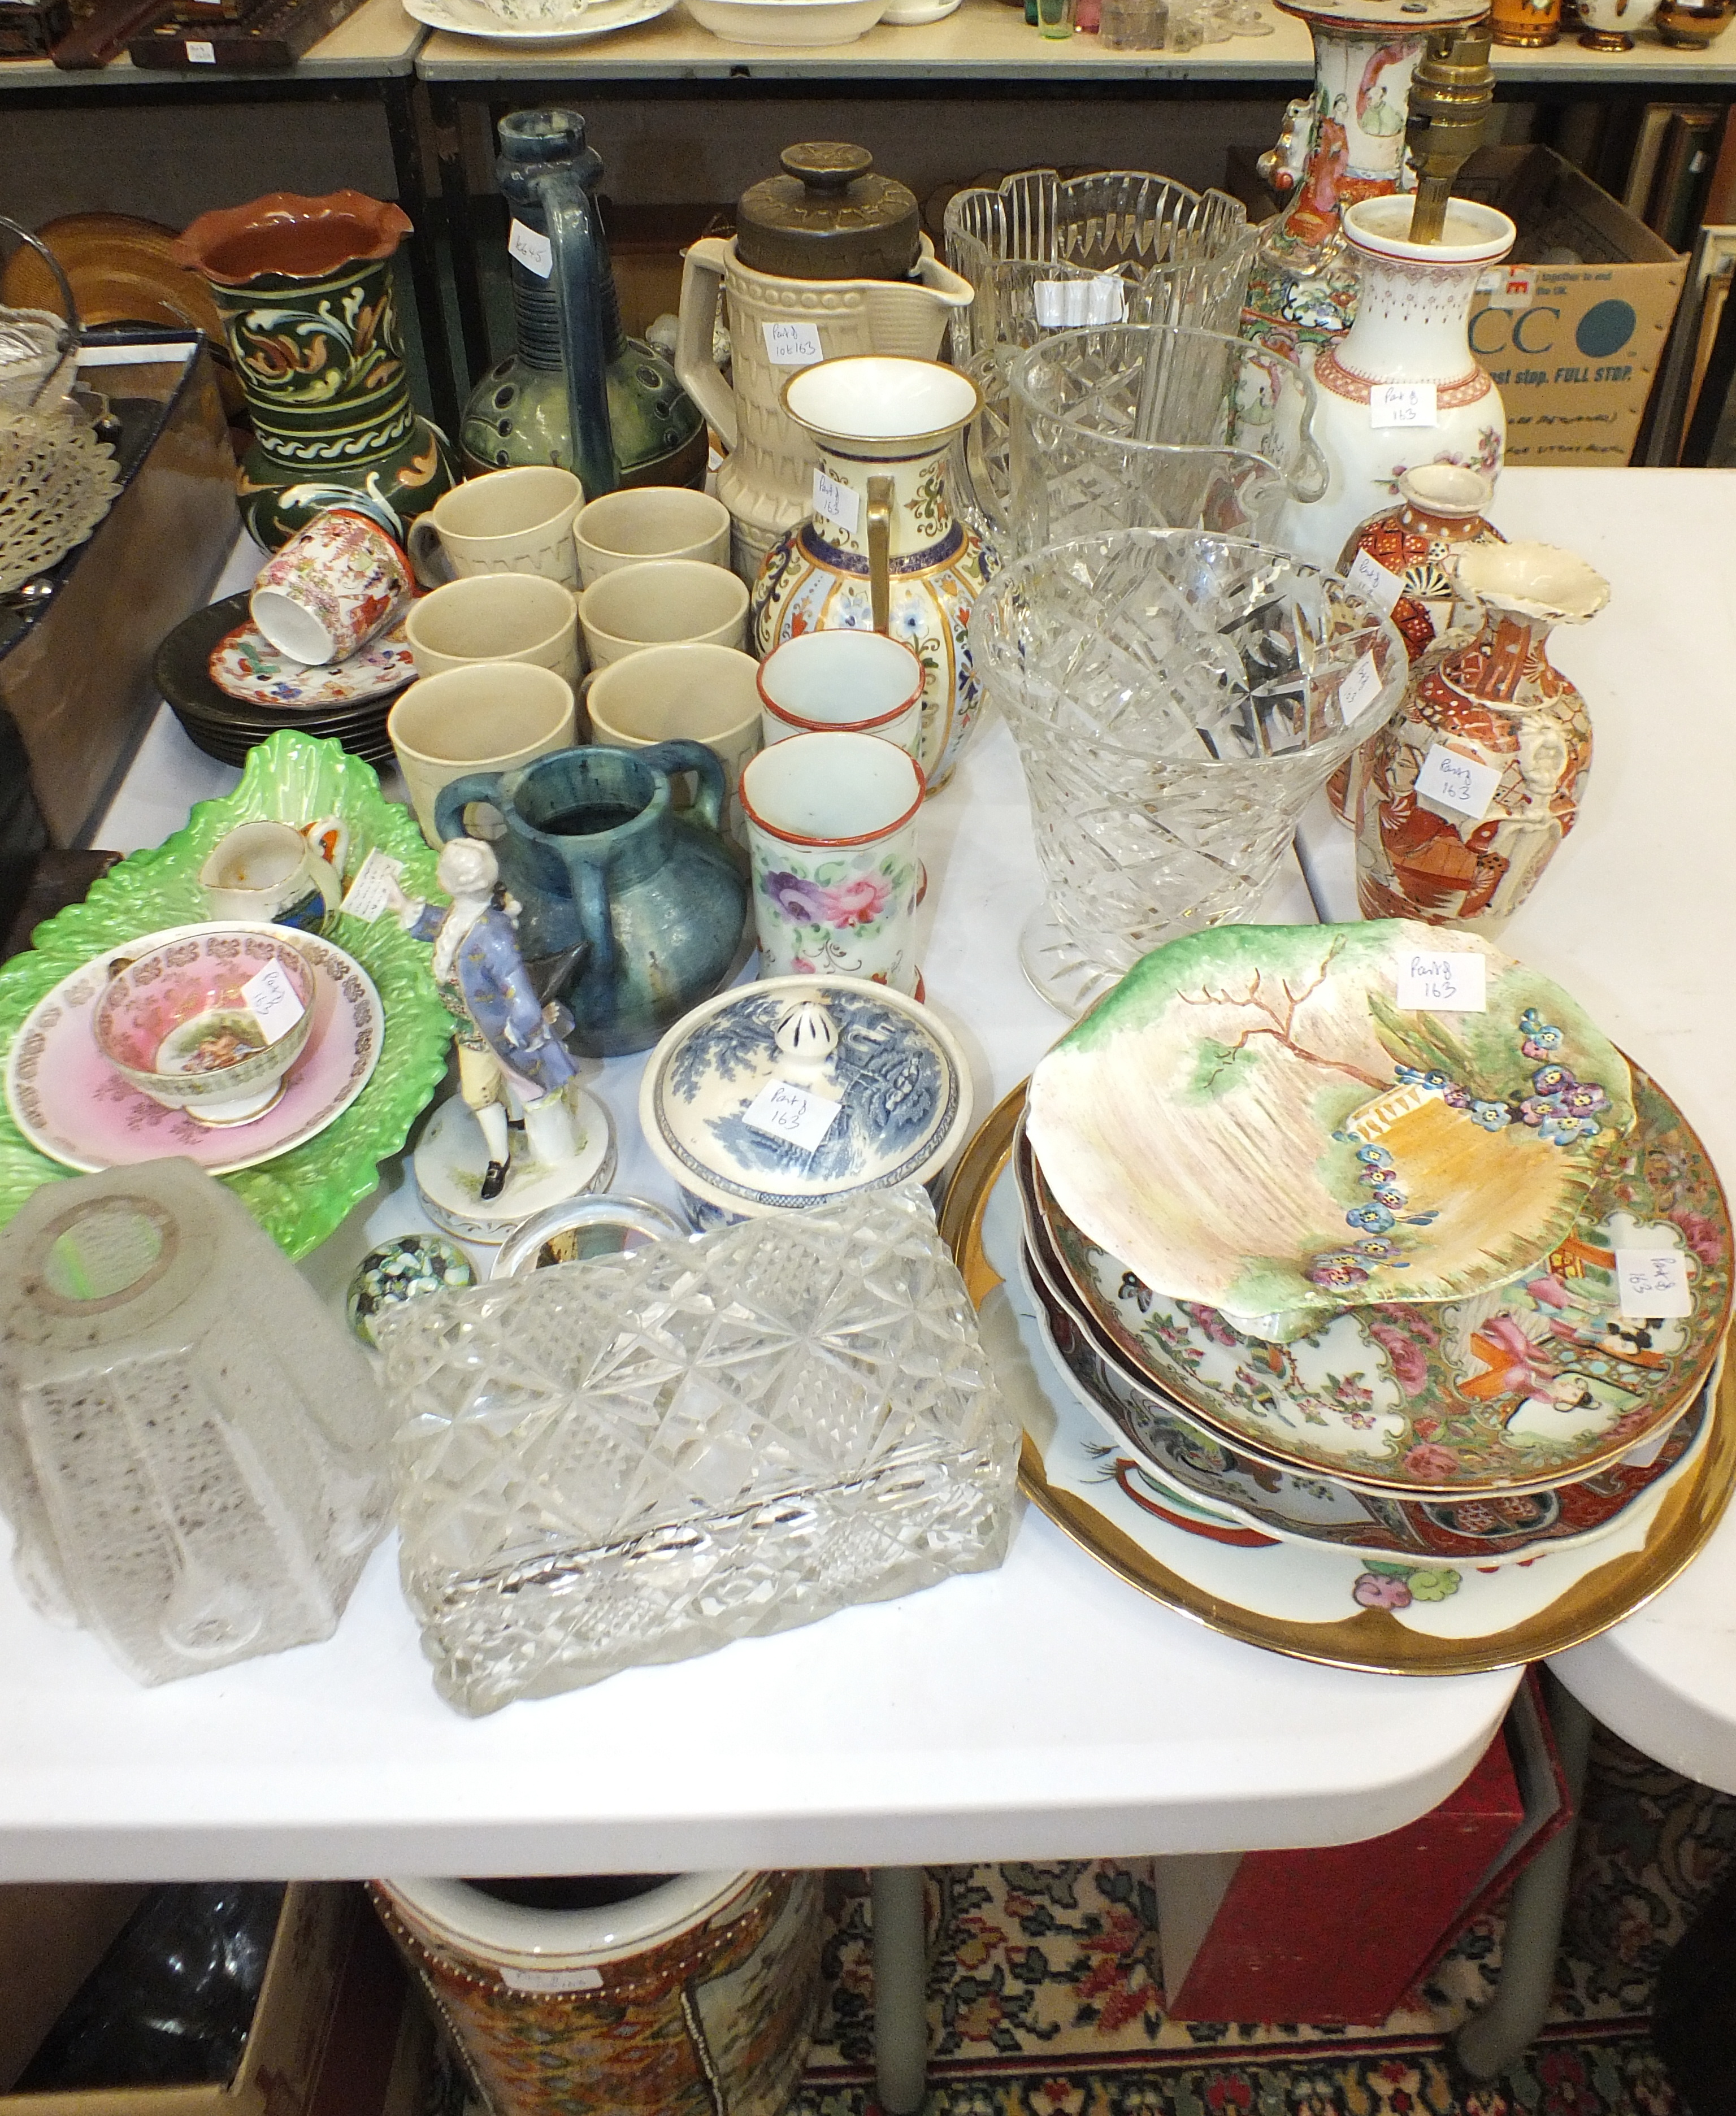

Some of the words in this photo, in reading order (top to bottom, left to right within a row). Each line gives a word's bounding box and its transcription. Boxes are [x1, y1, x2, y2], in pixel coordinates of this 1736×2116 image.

[795, 341, 816, 355] 163
[1554, 367, 1589, 383] FULL
[1392, 407, 1417, 420] 163
[823, 499, 840, 515] 163
[1442, 782, 1471, 800] 163
[1425, 981, 1457, 999] 163
[771, 1110, 800, 1129] 163
[1629, 1273, 1652, 1294] 163
